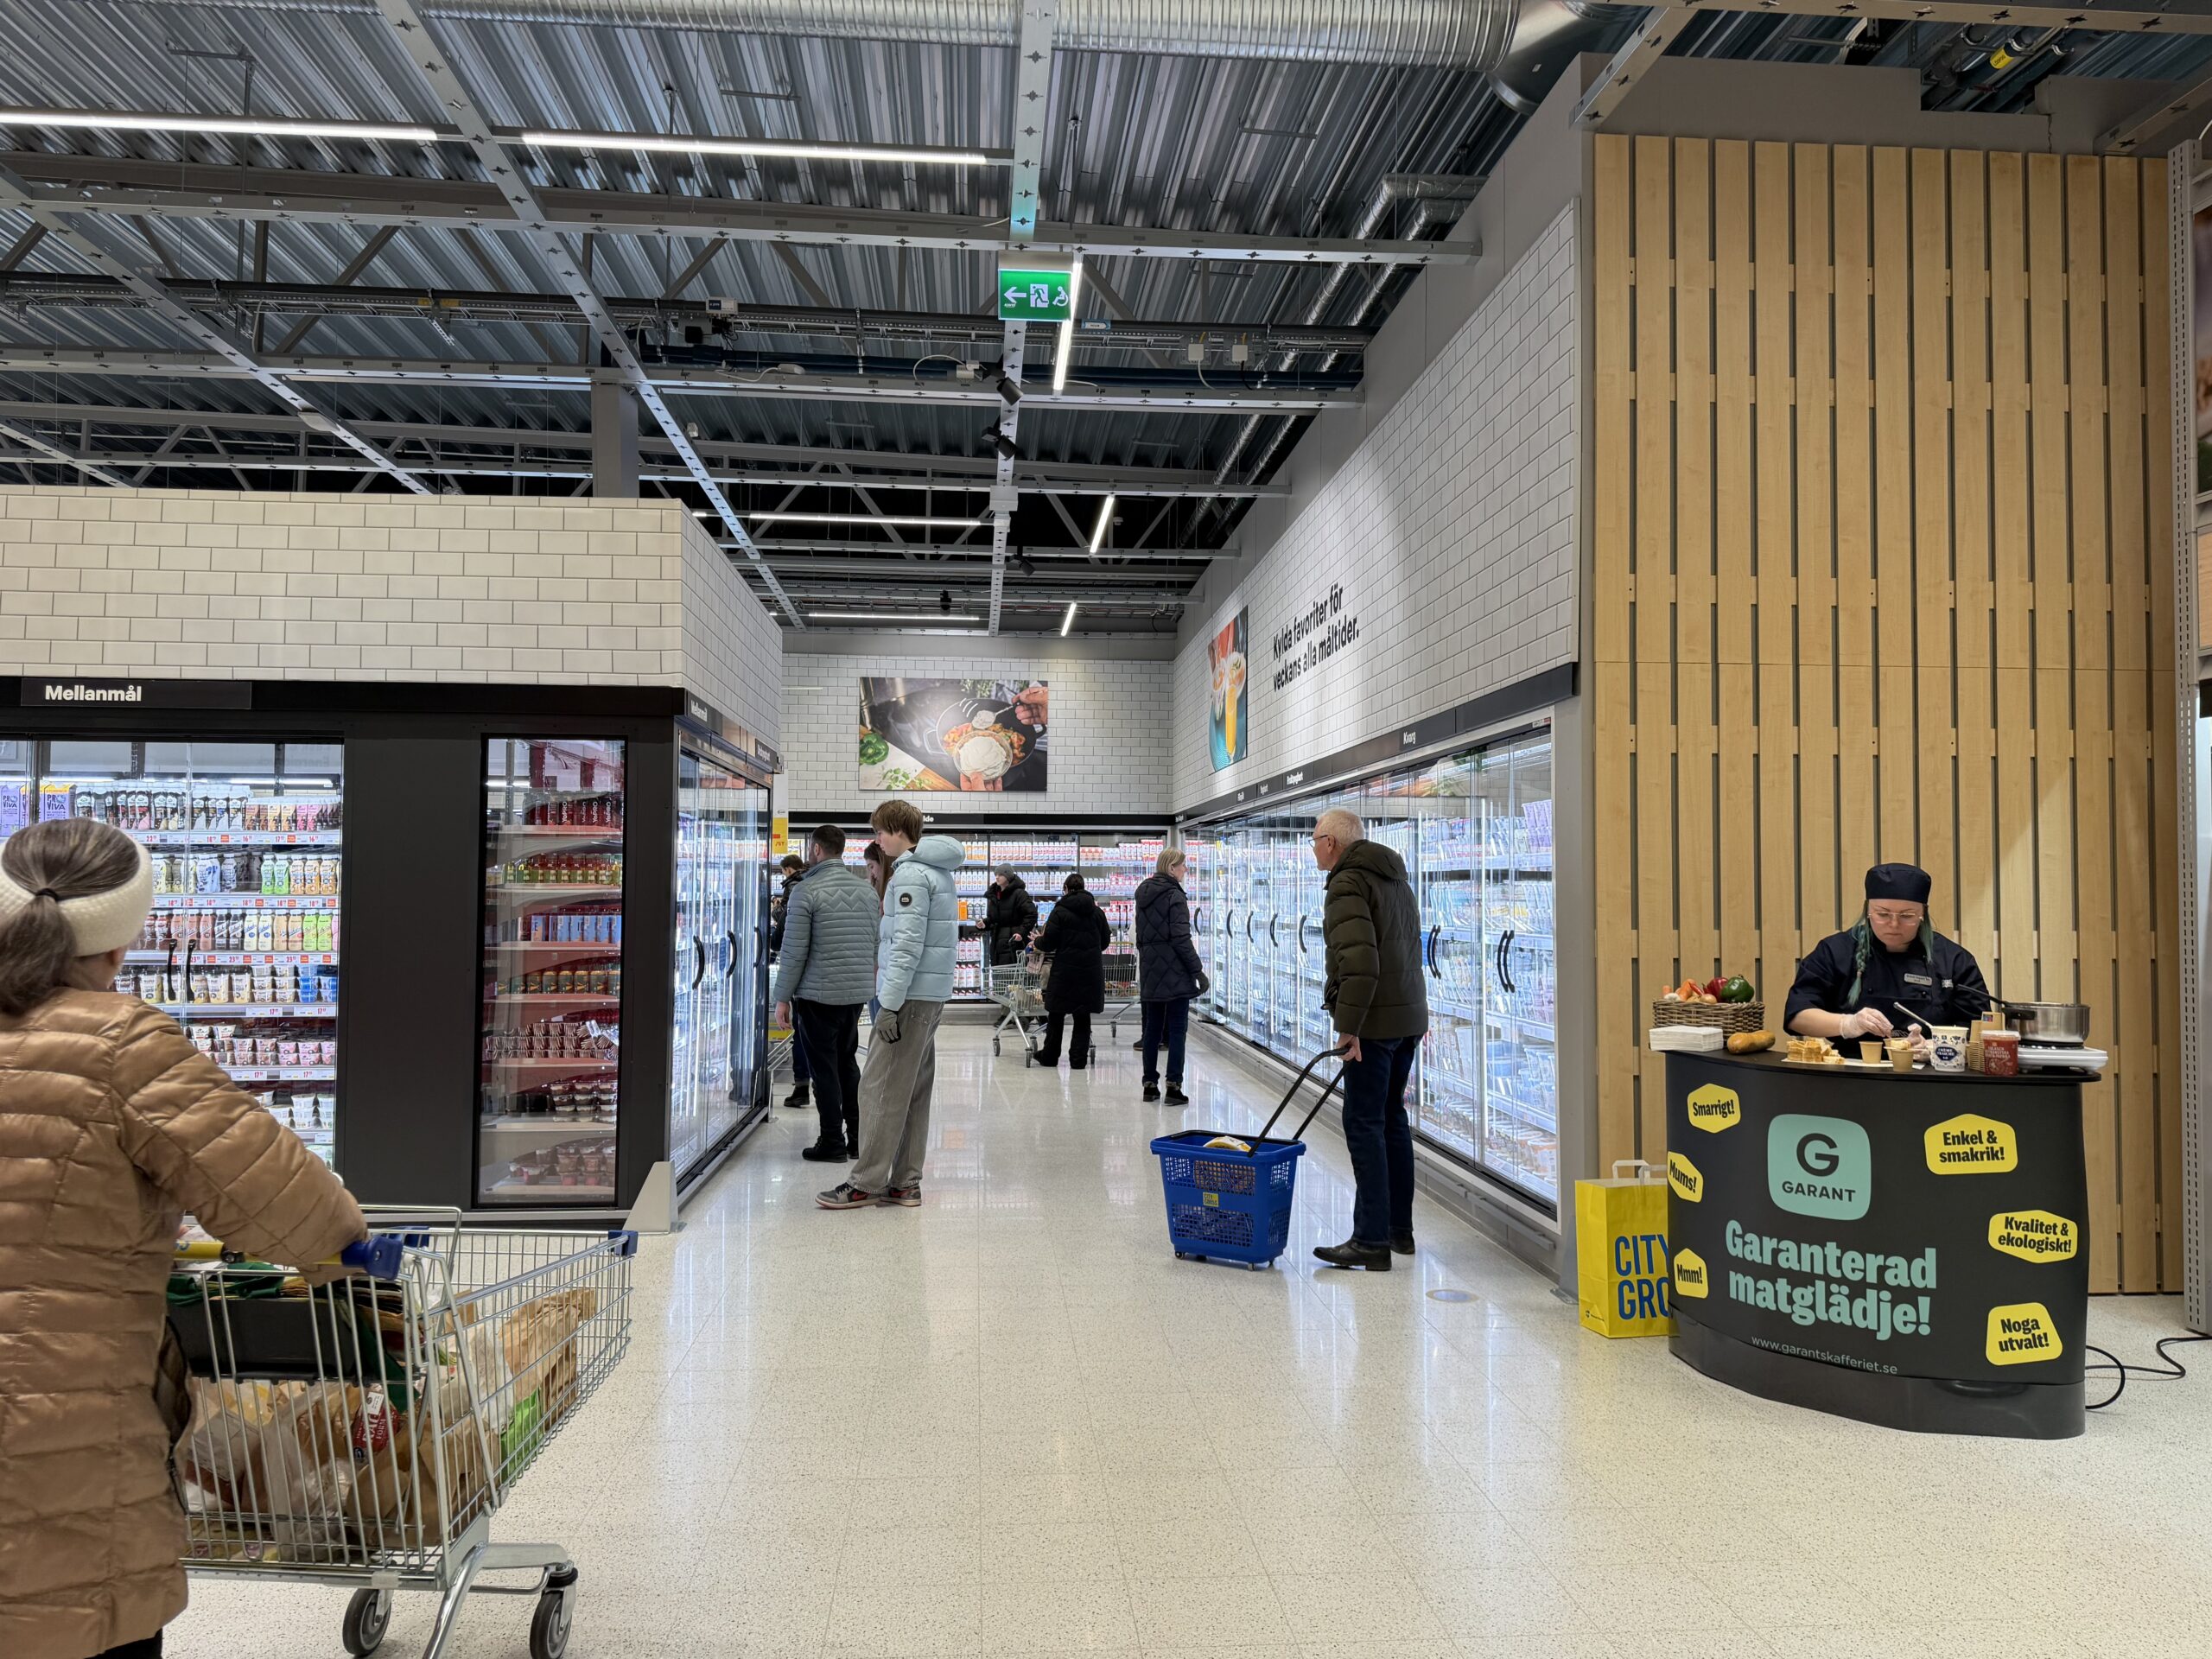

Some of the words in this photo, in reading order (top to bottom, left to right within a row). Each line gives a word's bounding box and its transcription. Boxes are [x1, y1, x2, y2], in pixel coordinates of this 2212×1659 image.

[1274, 624, 1293, 663] Kylda
[1294, 599, 1328, 645] favoriter
[1329, 582, 1343, 617] för
[1273, 658, 1301, 692] veckans
[1303, 640, 1317, 672] alla
[1319, 614, 1359, 664] måltider.
[45, 685, 142, 702] Mellanmål
[1403, 731, 1416, 745] Kvarg
[1692, 1098, 1735, 1118] Smarrigt!
[1942, 1130, 1983, 1147] Enkel
[1986, 1130, 1998, 1144] &
[1796, 1133, 1839, 1177] G
[1939, 1146, 2005, 1164] smakrik!
[1669, 1160, 1697, 1193] Mums!
[1782, 1180, 1856, 1202] GARANT
[2004, 1217, 2058, 1236] Kvalitet
[2059, 1222, 2069, 1236] &
[1998, 1231, 2072, 1254] ekologiskt!
[1726, 1219, 1936, 1288] Garanterad
[1676, 1264, 1703, 1284] Mmm!
[1729, 1270, 1931, 1341] matglädje!
[2000, 1316, 2040, 1336] Noga
[1999, 1332, 2050, 1352] utvalt!
[1751, 1336, 1898, 1375] www.garantskafferiet.se
